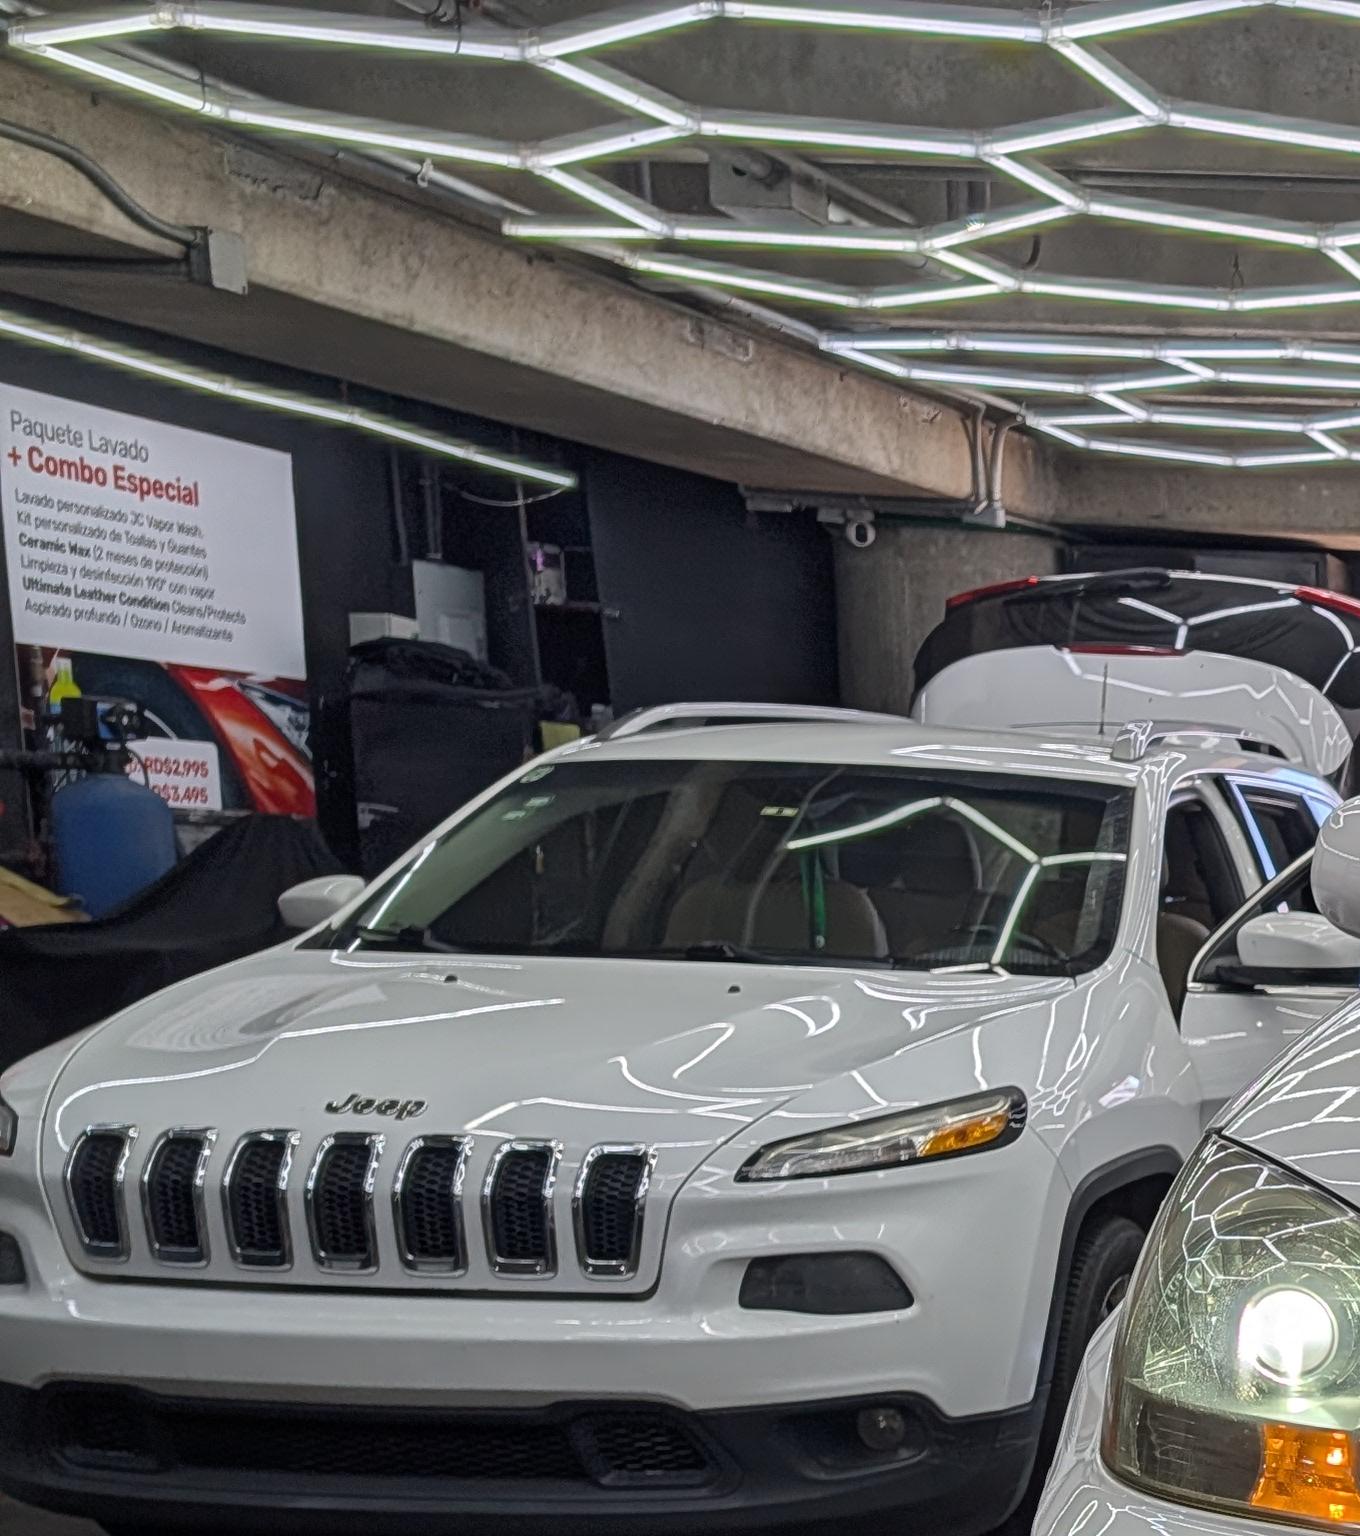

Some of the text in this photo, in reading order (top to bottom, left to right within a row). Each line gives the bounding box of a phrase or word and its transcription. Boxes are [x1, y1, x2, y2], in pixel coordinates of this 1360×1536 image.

[10, 409, 149, 464] Paquete Lavado
[27, 446, 108, 488] Combo
[112, 464, 199, 508] Especial
[15, 488, 54, 509] Lavado
[57, 498, 128, 524] personalizado
[17, 510, 207, 560] Kit personalizado de Toallas y Guantes
[19, 532, 66, 554] Ceramic
[68, 540, 91, 558] Wax
[105, 550, 138, 568] meses
[140, 554, 153, 570] de
[20, 554, 68, 576] Limpieza
[70, 565, 78, 580] y
[22, 575, 71, 597] Ultimate
[74, 584, 116, 604] Leather
[119, 590, 170, 613] Condition
[25, 597, 71, 619] Aspirado
[73, 606, 121, 627] profundo
[324, 1093, 428, 1121] Jeep
